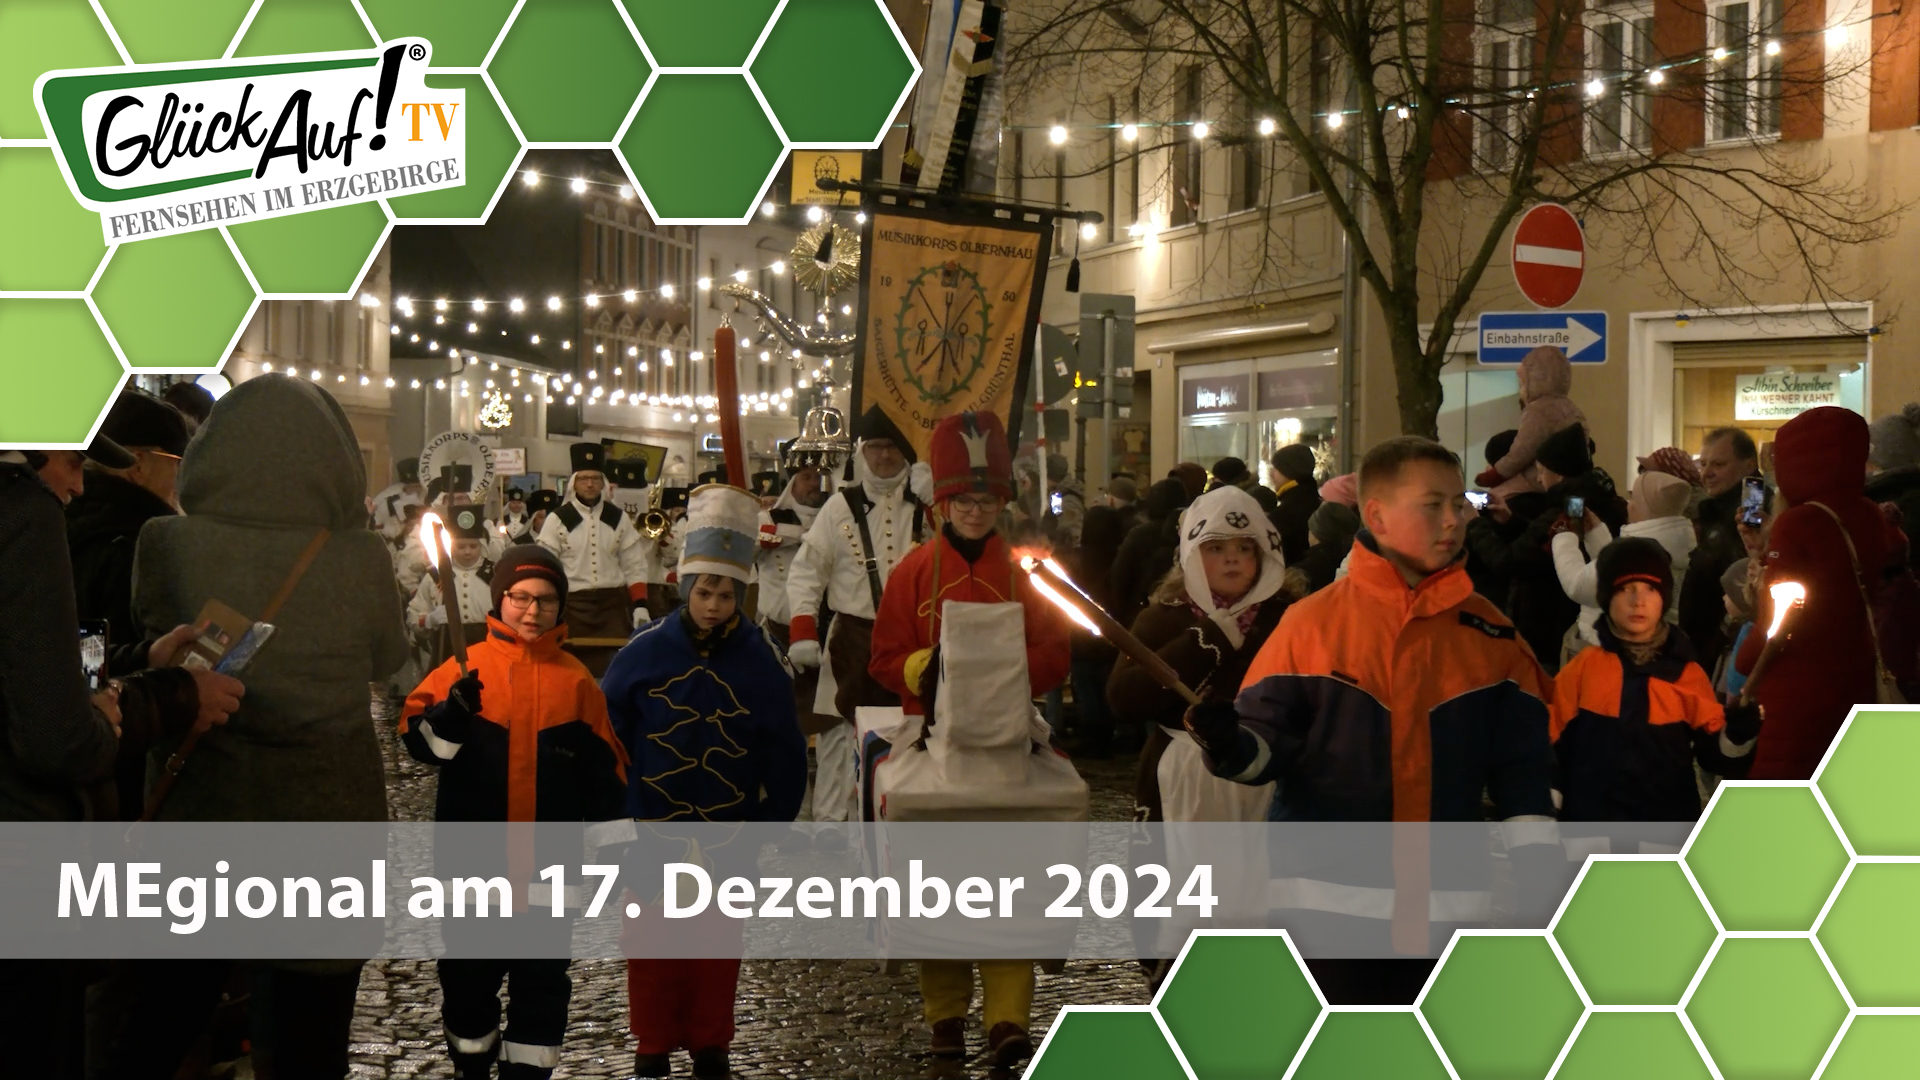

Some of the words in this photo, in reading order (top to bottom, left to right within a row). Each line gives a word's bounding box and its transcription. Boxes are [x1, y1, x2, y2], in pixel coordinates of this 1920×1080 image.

[877, 230, 957, 251] MUSIKKORPS
[959, 240, 1033, 260] OLBERNHAU
[880, 275, 892, 287] 19
[1002, 291, 1016, 302] 50
[1486, 332, 1570, 344] Einbahnstraße
[1742, 377, 1778, 393] Albin
[1779, 375, 1833, 392] Schreiber
[1760, 394, 1800, 404] WERNER
[1802, 393, 1835, 403] KAHNT
[420, 431, 469, 486] USIKKORPS
